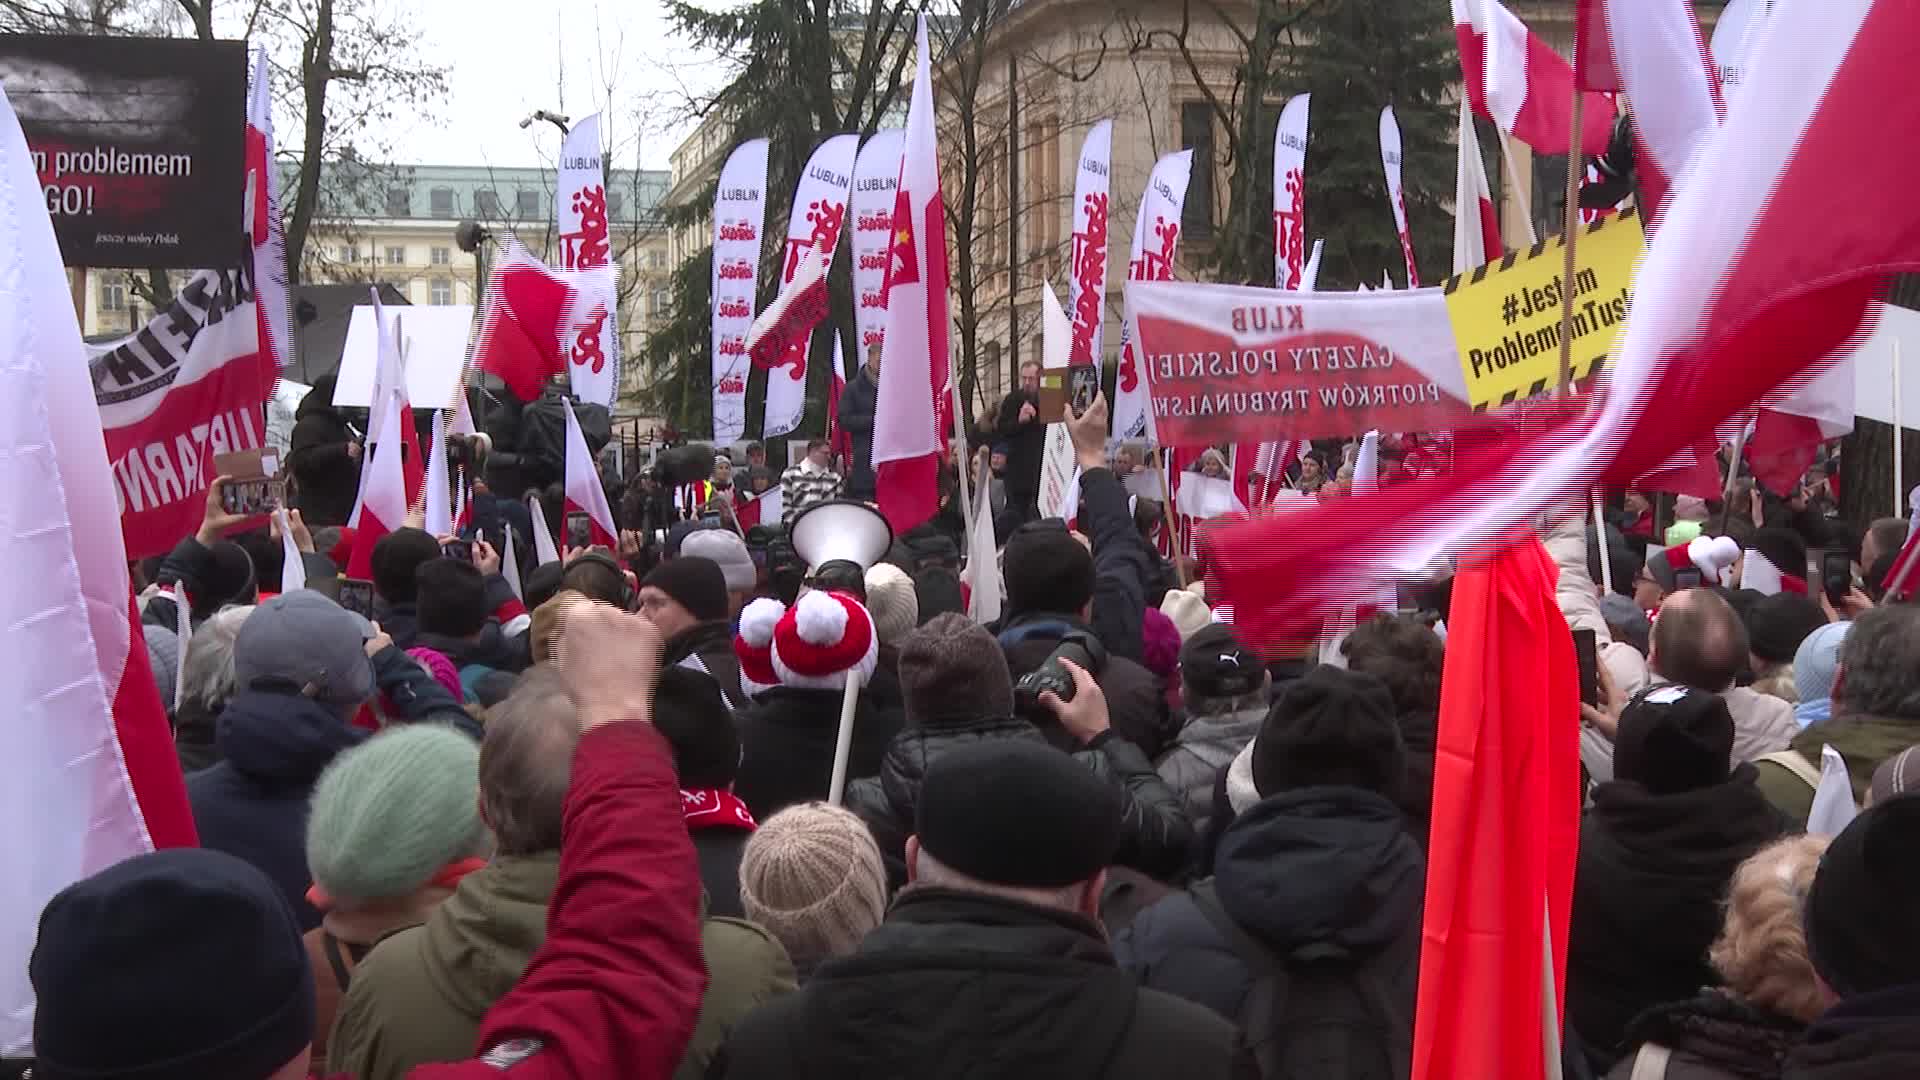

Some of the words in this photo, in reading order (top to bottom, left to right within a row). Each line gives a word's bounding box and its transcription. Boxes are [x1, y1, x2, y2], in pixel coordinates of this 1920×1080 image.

[55, 146, 192, 178] problemem
[564, 157, 600, 171] LUBLIN
[1082, 157, 1108, 177] LUBLIN
[810, 165, 849, 190] LUBLIN
[857, 178, 898, 192] LUBLIN
[721, 188, 760, 201] LUBLIN
[154, 232, 180, 245] Polak
[1501, 267, 1599, 326] #Jestm
